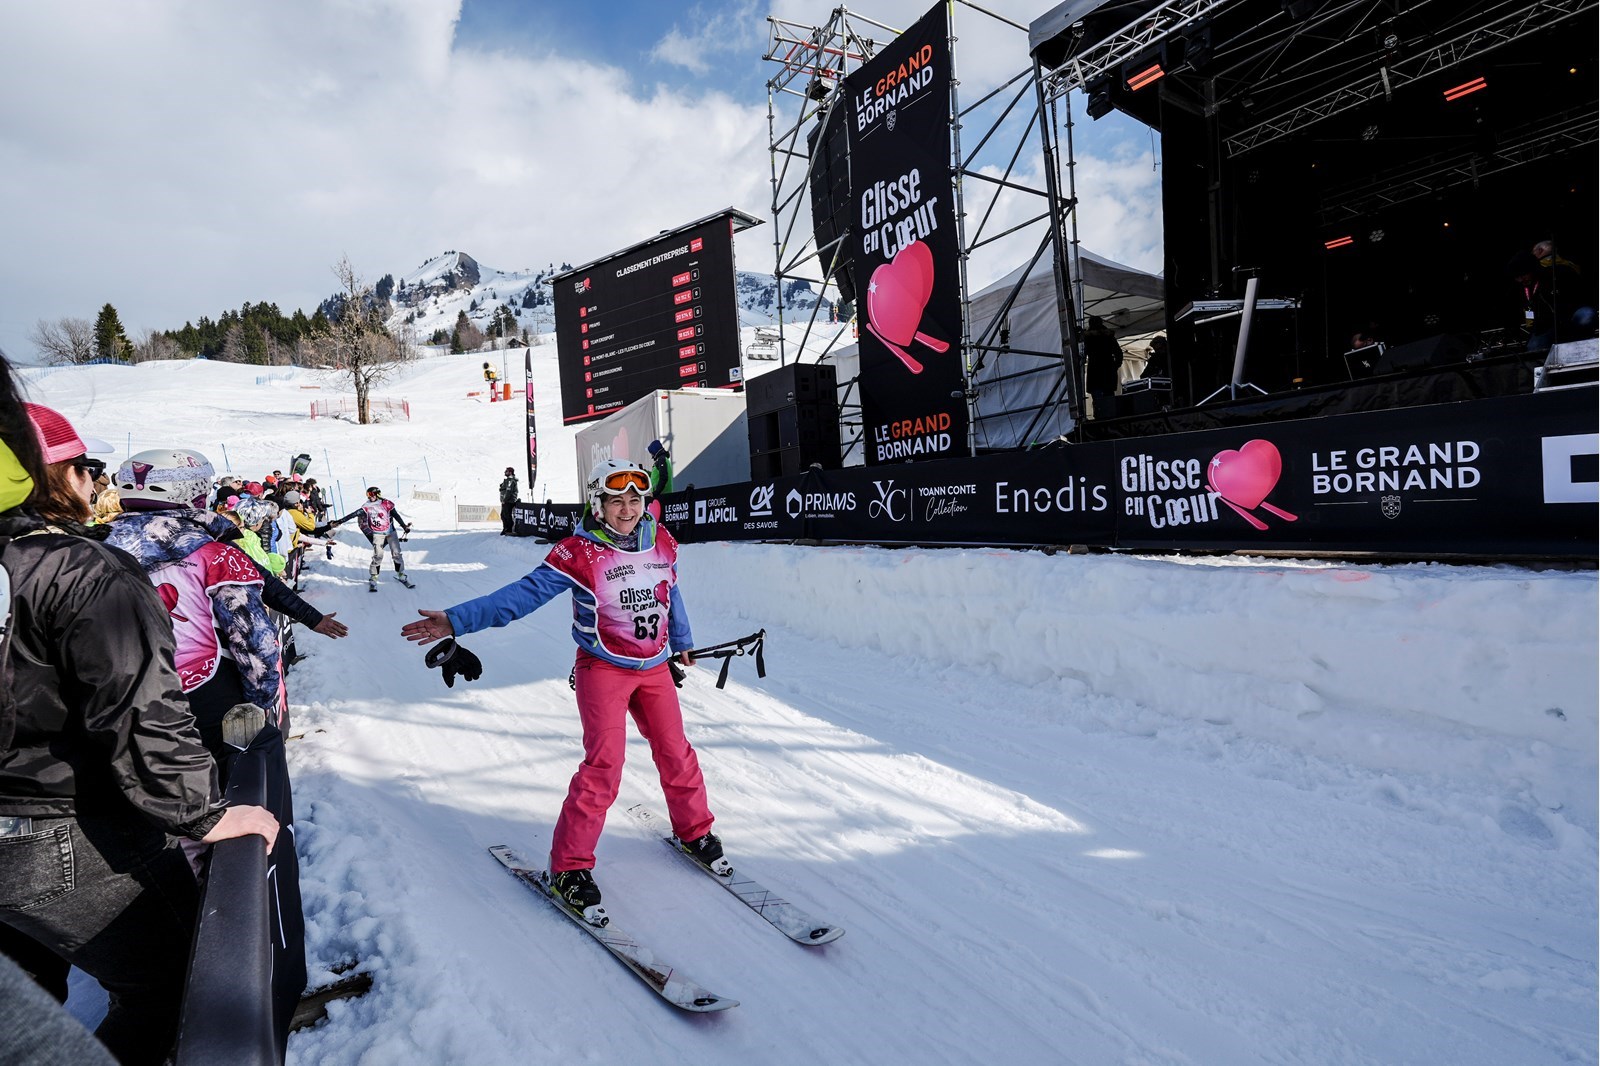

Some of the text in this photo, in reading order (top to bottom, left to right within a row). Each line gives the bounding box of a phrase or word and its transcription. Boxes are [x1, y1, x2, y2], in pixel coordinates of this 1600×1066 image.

[856, 44, 932, 112] LE GRAND
[858, 66, 934, 132] BORNAND
[862, 168, 920, 229] Glisse
[864, 196, 938, 259] en Cœur
[616, 259, 652, 278] CLASSEMENT
[652, 245, 688, 264] ENTREPRISE
[875, 412, 951, 442] LE GRAND
[877, 433, 951, 461] BORNAND
[1312, 441, 1480, 472] LE GRAND
[1121, 454, 1200, 492] Glisse
[1313, 467, 1481, 494] BORNAND
[708, 497, 726, 507] GROUPE
[805, 492, 856, 510] PRIAMS
[919, 484, 976, 496] YOANN CONTE
[996, 476, 1108, 513] Enodis
[665, 502, 689, 513] LE GRAND
[665, 512, 689, 521] BORNAND
[708, 507, 738, 523] APICIL
[926, 497, 967, 522] Collection
[1126, 492, 1221, 528] en Cœur
[756, 521, 778, 529] SAVOIE
[606, 570, 635, 581] BORNAND
[613, 564, 633, 573] GRAND
[620, 588, 652, 604] Glisse
[634, 614, 660, 640] 63
